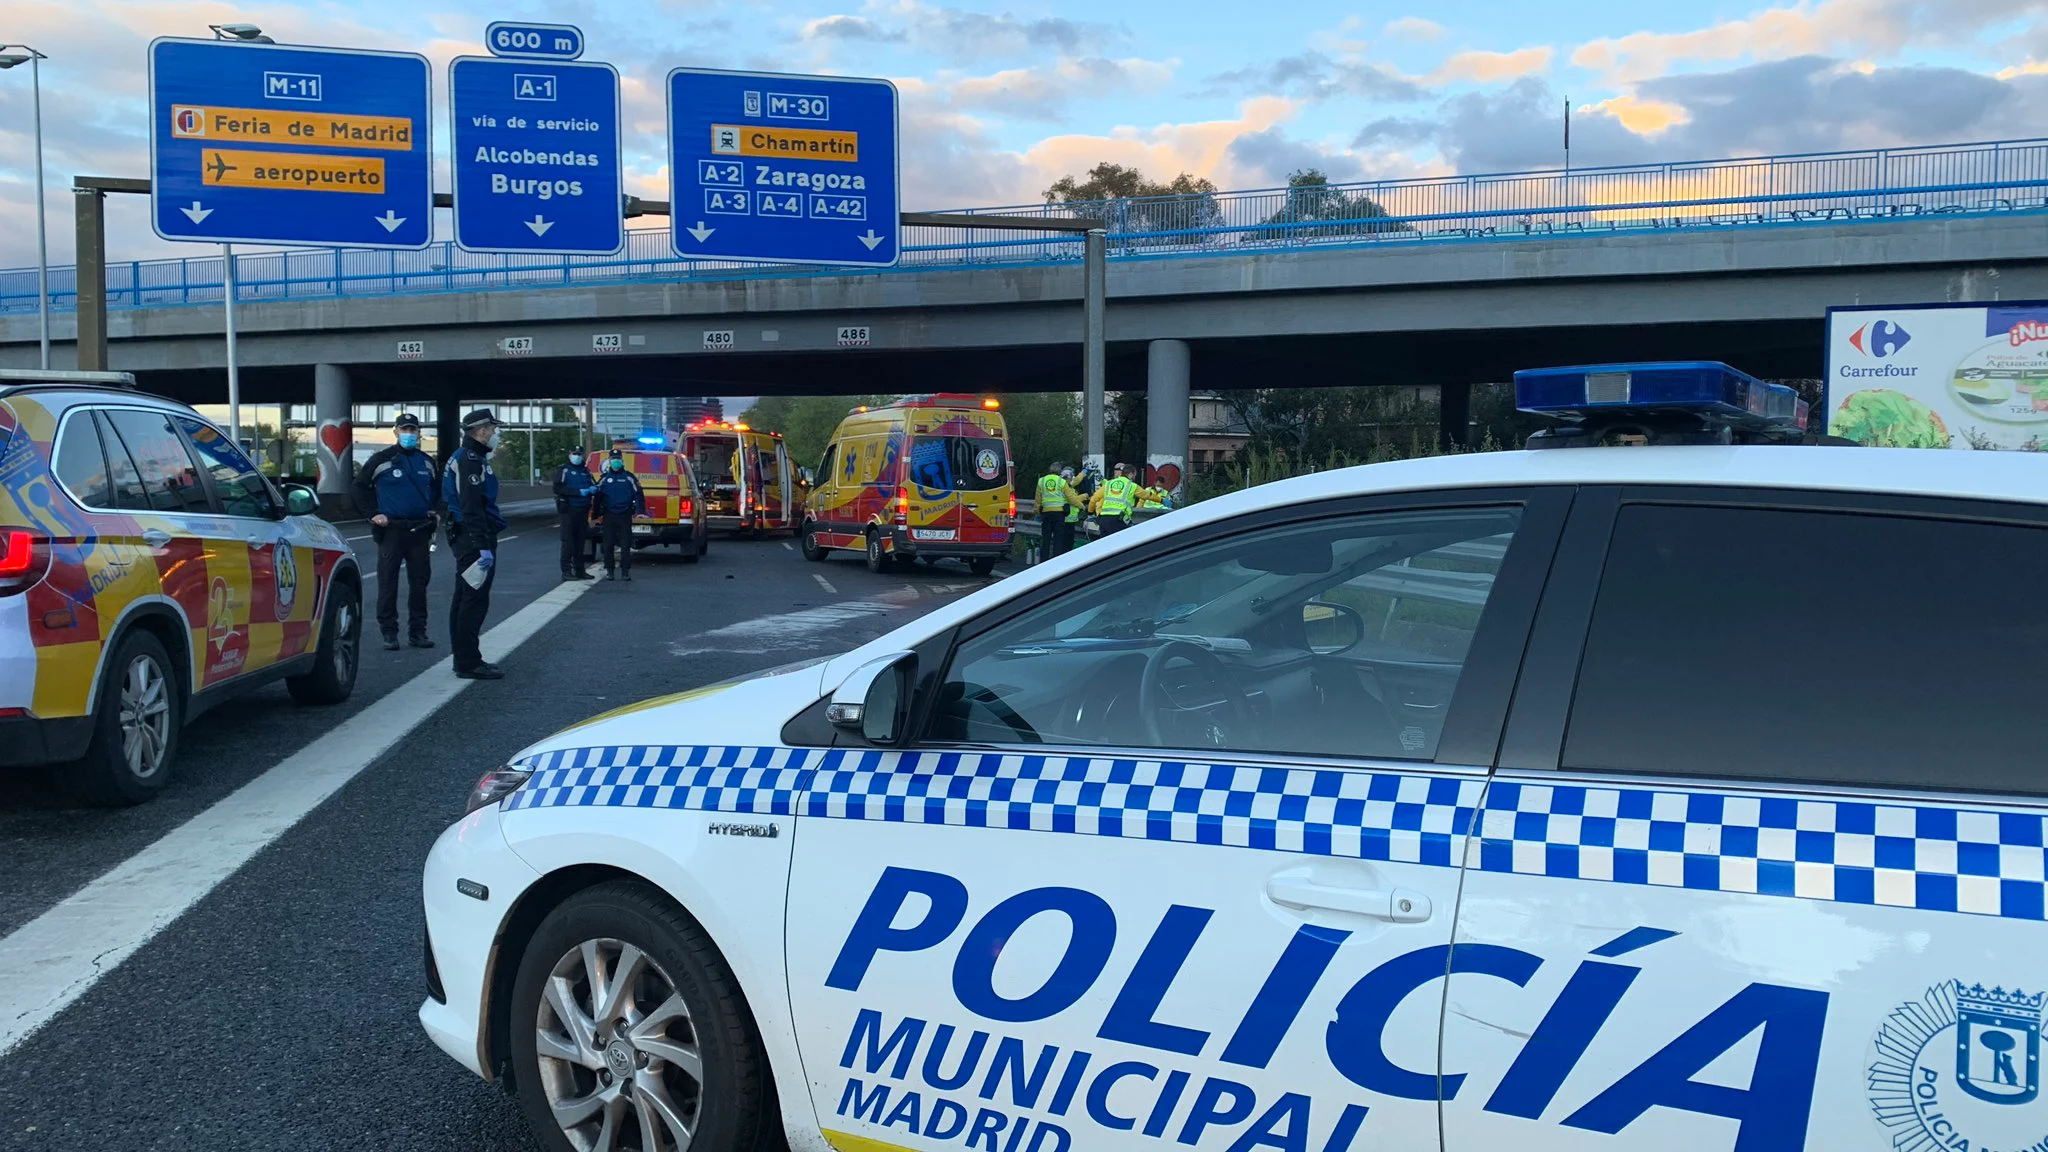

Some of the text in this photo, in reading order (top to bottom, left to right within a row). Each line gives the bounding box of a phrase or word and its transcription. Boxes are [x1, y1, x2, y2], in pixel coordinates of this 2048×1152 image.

[497, 30, 572, 51] 600 m
[269, 77, 317, 97] M-11
[520, 79, 552, 97] A-1
[771, 97, 825, 115] M-30
[215, 115, 409, 143] Feria de Madrid
[472, 115, 599, 131] vía de servicio
[751, 133, 855, 155] Chamartín
[475, 146, 599, 166] Alcobendas
[254, 165, 381, 185] aeropuerto
[705, 165, 866, 191] A-2 Zaragoza
[491, 173, 583, 200] Burgos
[710, 193, 862, 216] A-3 A-4 A-42
[1839, 364, 1918, 378] Carrefour
[708, 822, 769, 838] HYBRID
[824, 866, 1830, 1152] POLICÍA
[836, 1077, 1072, 1152] MADRID
